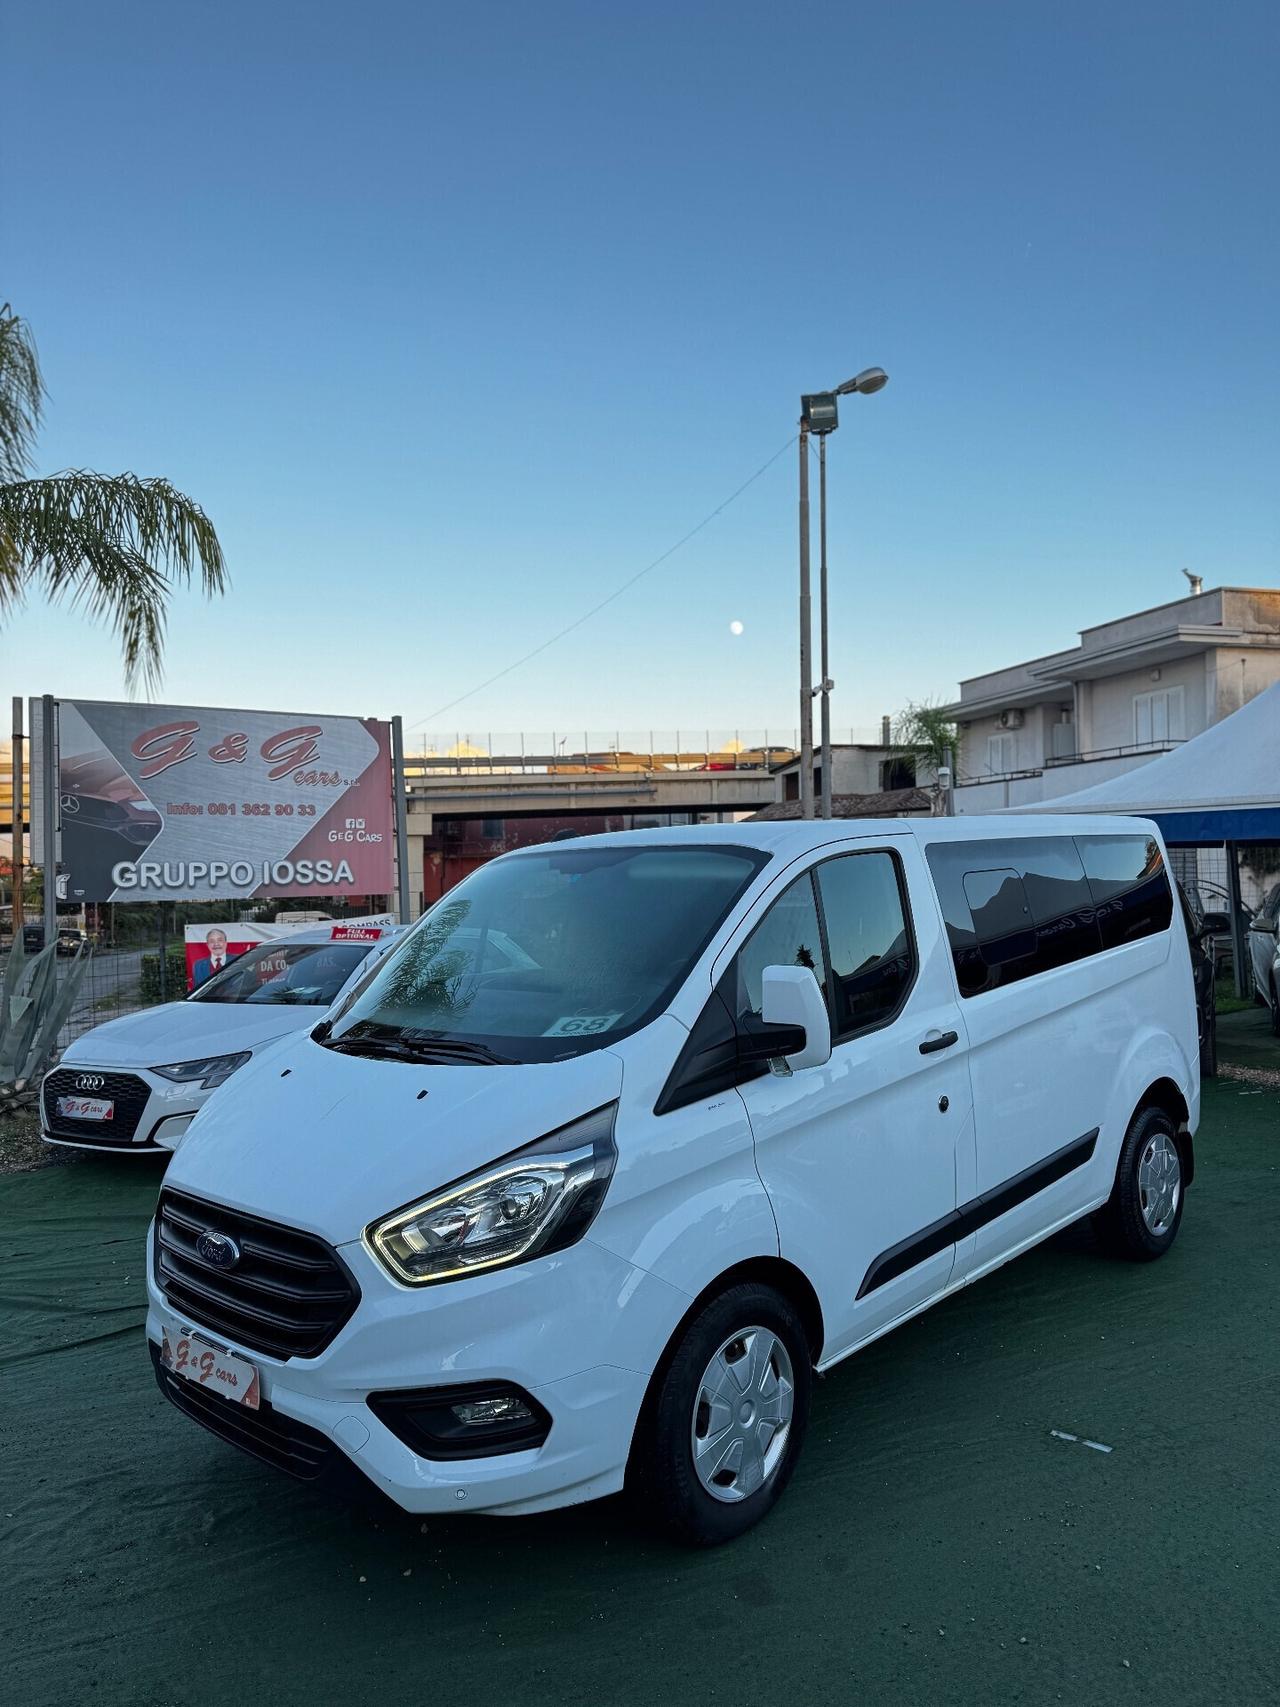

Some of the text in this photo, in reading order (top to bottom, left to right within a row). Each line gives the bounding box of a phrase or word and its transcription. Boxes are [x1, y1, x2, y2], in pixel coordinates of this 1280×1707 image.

[208, 732, 249, 763] &
[207, 802, 237, 816] 081
[241, 803, 271, 816] 362
[274, 804, 294, 816] 90
[111, 859, 355, 889] GRUPPO IOSSA
